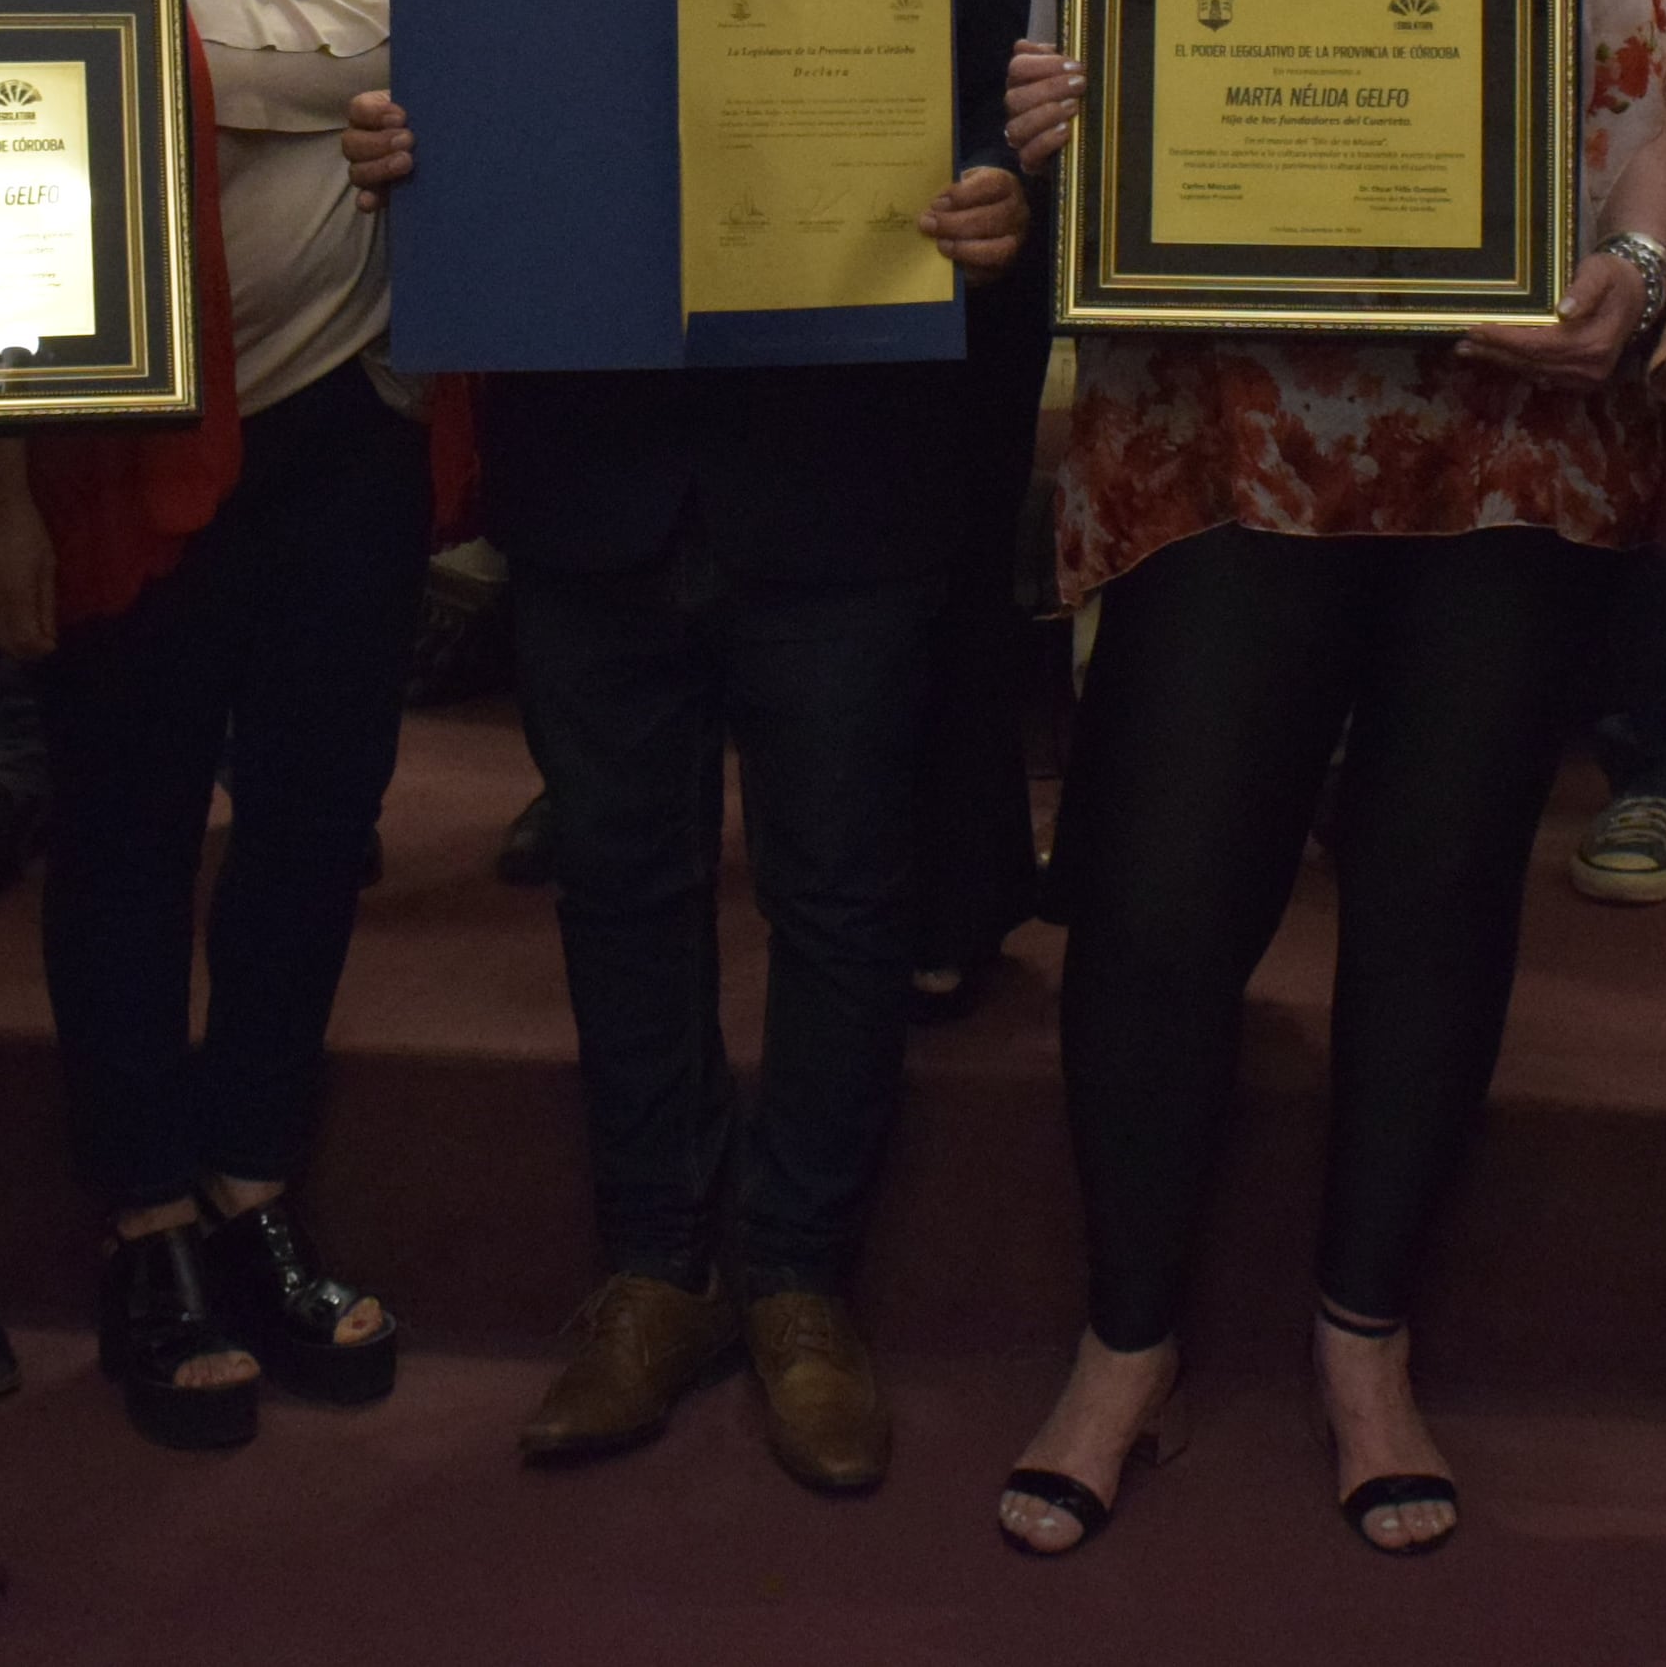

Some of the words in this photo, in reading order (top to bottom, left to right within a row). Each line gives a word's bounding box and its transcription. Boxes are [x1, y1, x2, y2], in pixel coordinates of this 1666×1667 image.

[1174, 43, 1186, 58] EL
[1190, 44, 1227, 58] PODER
[1230, 44, 1295, 58] LEGISLATIVO
[1298, 45, 1312, 58] DE
[1315, 45, 1329, 58] LA
[1333, 45, 1389, 59] PROVINCIA
[1392, 45, 1406, 59] DE
[1410, 43, 1461, 60] CÓRDOBA
[793, 66, 850, 78] Declara
[1225, 86, 1283, 108] MARTA
[1289, 82, 1349, 108] NÉLIDA
[1356, 87, 1410, 109] GELFO
[1245, 115, 1259, 125] de
[12, 136, 66, 152] CÓRDOBA
[4, 184, 60, 206] GELFO
